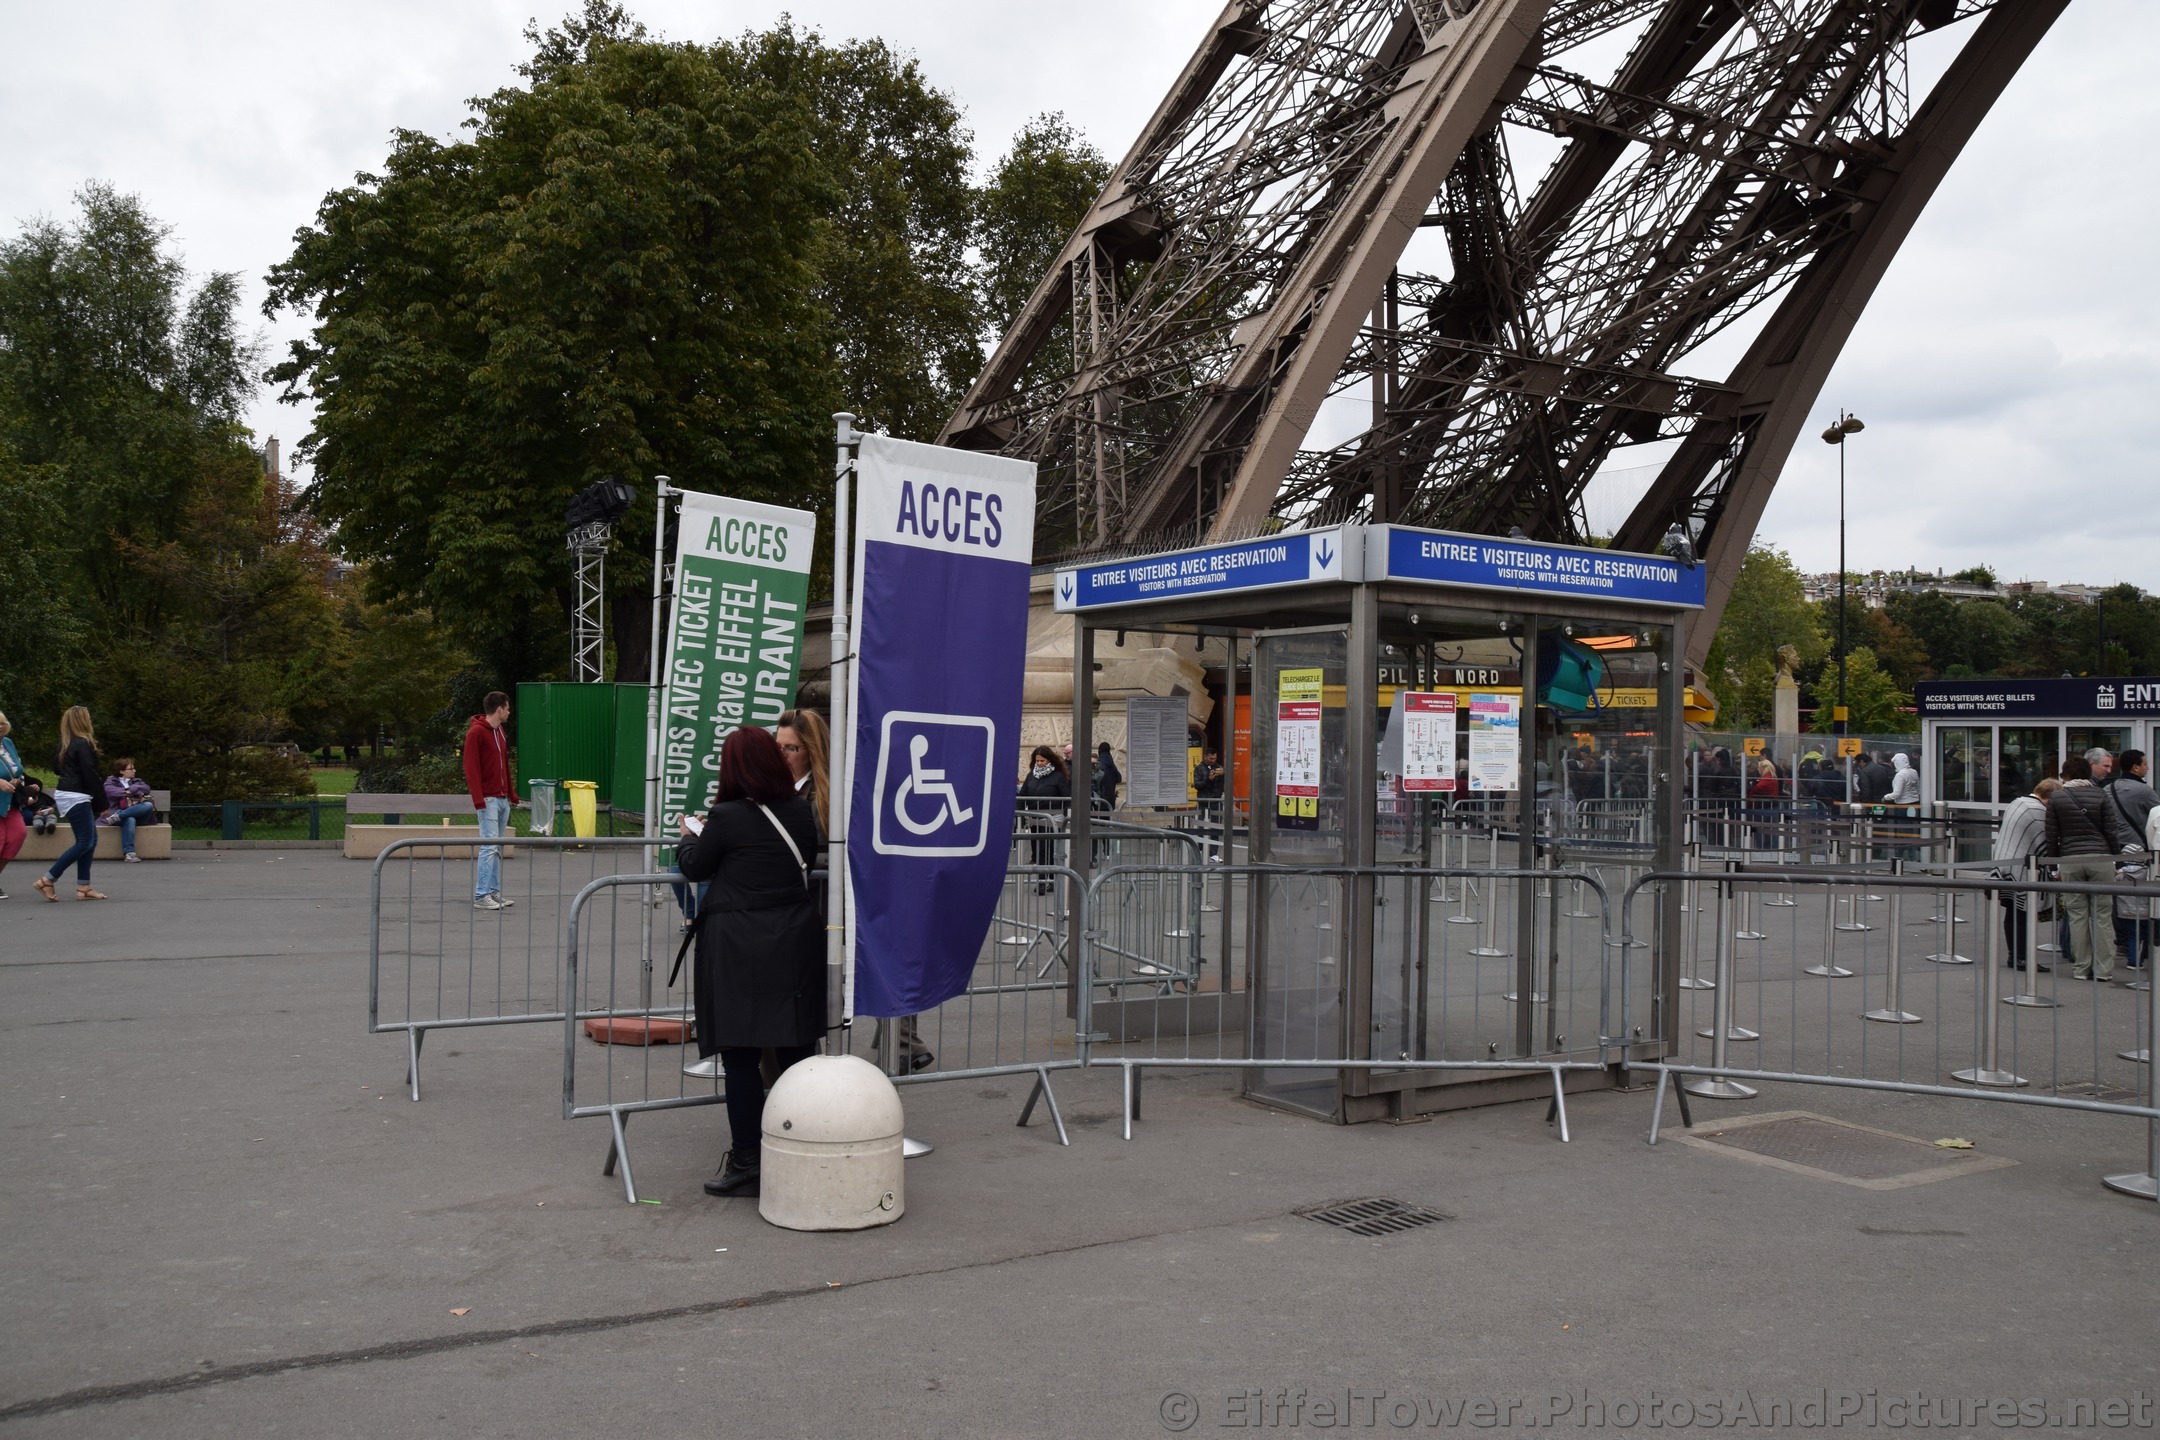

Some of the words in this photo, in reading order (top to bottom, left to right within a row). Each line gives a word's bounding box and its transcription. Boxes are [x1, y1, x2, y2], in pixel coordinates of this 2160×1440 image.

[896, 480, 1003, 548] ACCES
[705, 516, 788, 563] ACCES
[1092, 570, 1126, 588] ENTREE
[1129, 562, 1177, 583] VISITEURS
[1180, 558, 1207, 576] AVEC
[1210, 545, 1287, 572] RESERVATION
[1138, 580, 1165, 592] VISITORS
[1167, 578, 1182, 588] WITH
[1183, 572, 1227, 587] RESERVATION
[1421, 541, 1478, 563] ENTREE
[1482, 548, 1552, 570] VISITEURS
[1556, 556, 1590, 574] AVEC
[1594, 560, 1678, 583] RESERVATION
[1497, 568, 1535, 581] VISITORS
[1537, 572, 1558, 583] WITH
[1560, 574, 1613, 588] RESERVATION
[676, 569, 713, 651] TICKET
[714, 578, 759, 664] EIFFEL
[751, 592, 798, 736] URANT
[1378, 667, 1439, 684] PILER
[1455, 669, 1499, 685] NORD
[670, 659, 705, 721] AVEC
[1616, 696, 1647, 706] TICKETS
[1925, 694, 1948, 702] ACCES
[1949, 694, 1984, 702] VISITEURS
[1985, 694, 2004, 702] AVEC
[2006, 693, 2036, 701] BILLETS
[1957, 702, 1975, 710] WITH
[1976, 702, 2006, 710] TICKETS
